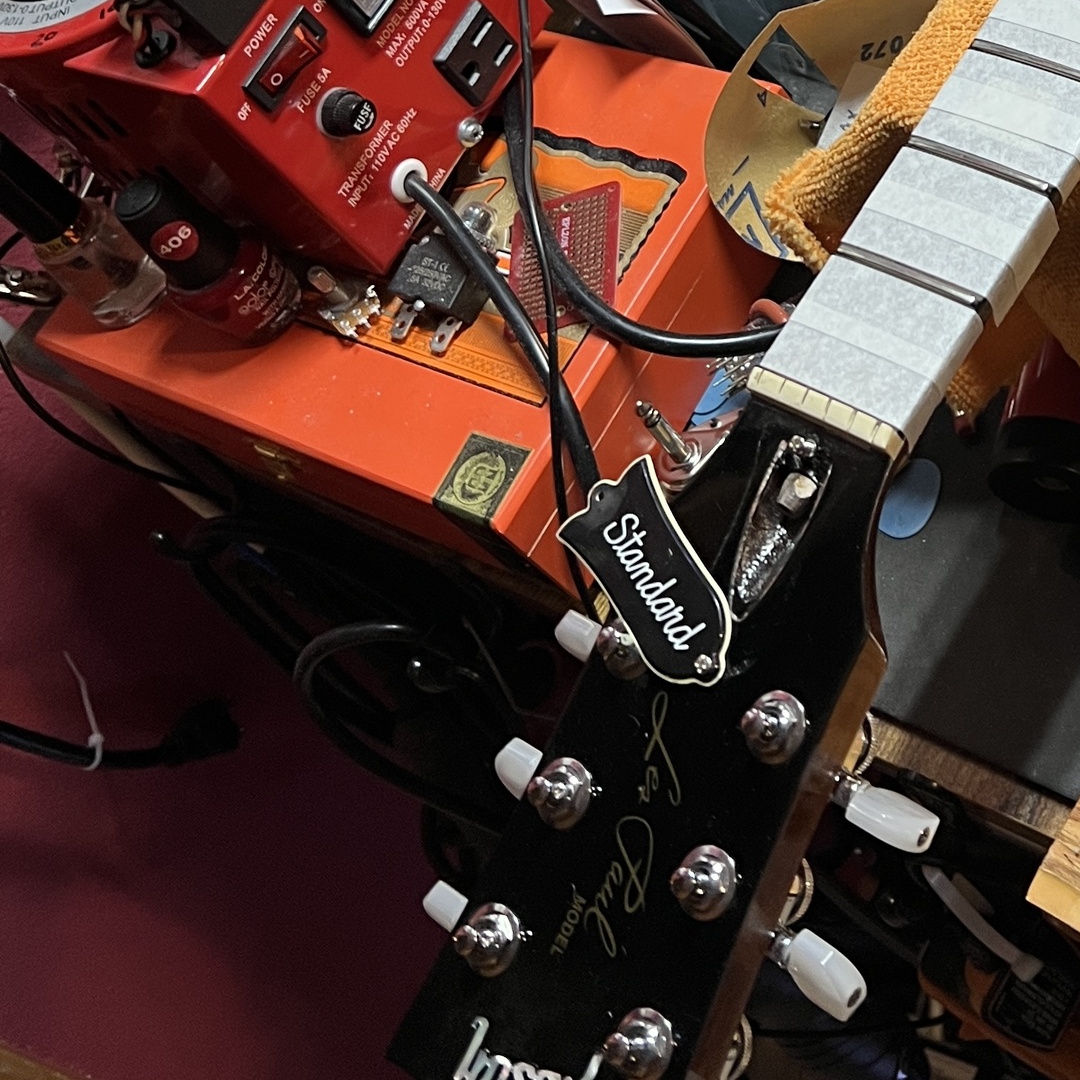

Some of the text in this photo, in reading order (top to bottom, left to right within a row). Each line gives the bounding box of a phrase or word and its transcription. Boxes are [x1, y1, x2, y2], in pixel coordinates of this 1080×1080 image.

[32, 6, 70, 24] INPUT
[243, 12, 279, 58] POWER
[376, 12, 404, 48] MODEL
[235, 102, 254, 122] OFF
[295, 66, 332, 114] FUSE 5A
[395, 107, 418, 134] 60Hz
[337, 119, 394, 199] TRANSFORMER
[428, 167, 446, 189] HINA
[158, 223, 193, 257] 406
[604, 513, 706, 651] Standard
[637, 690, 683, 807] Les
[584, 815, 655, 959] Paul
[549, 891, 587, 957] MODEL
